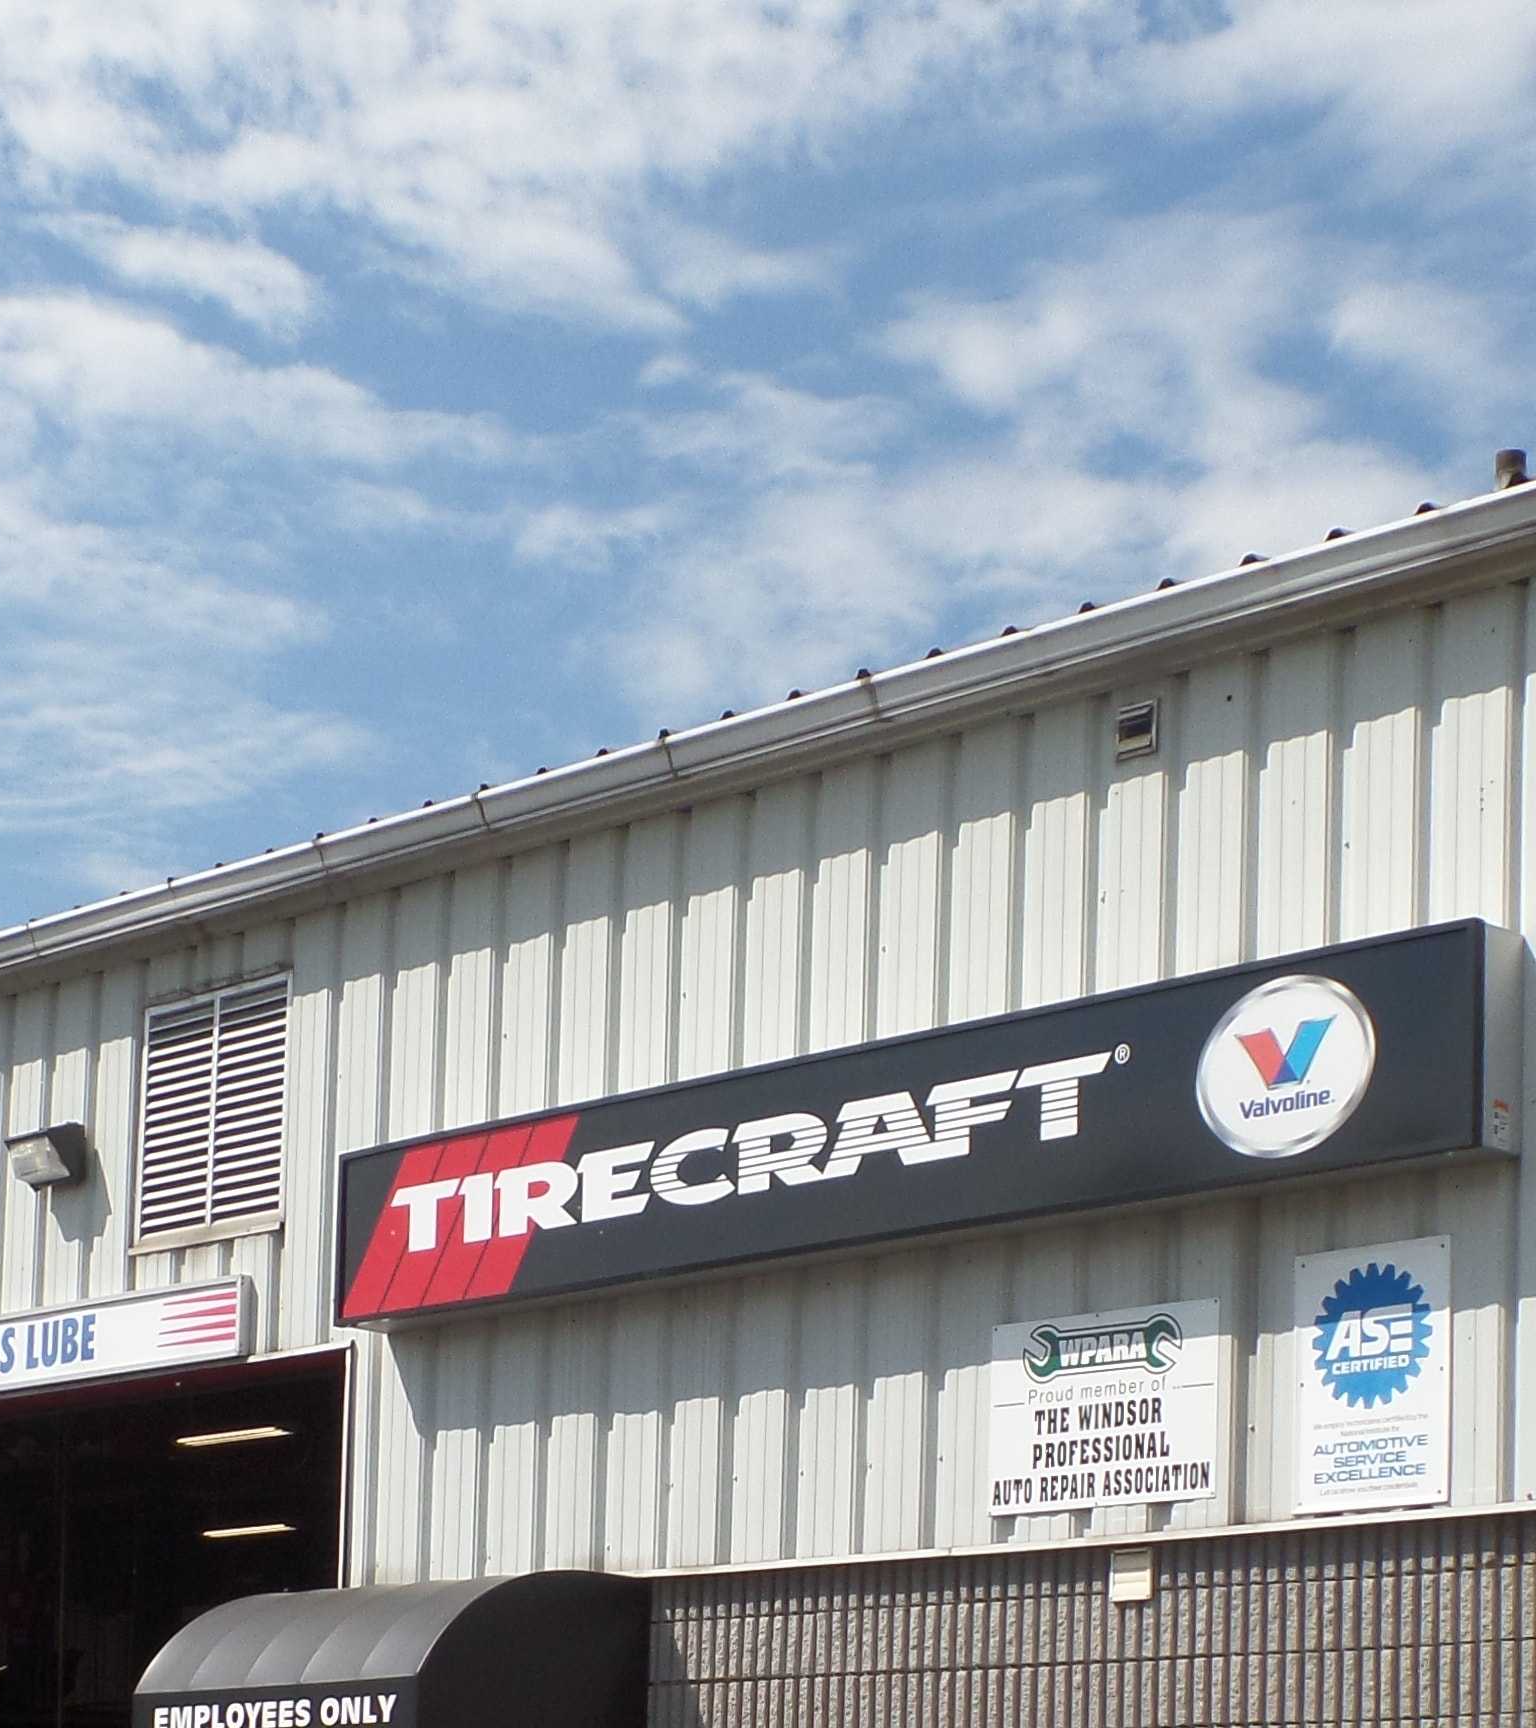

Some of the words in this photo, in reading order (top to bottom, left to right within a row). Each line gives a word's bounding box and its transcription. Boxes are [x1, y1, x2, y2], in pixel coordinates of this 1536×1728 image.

[1240, 1089, 1331, 1119] Valvoline
[26, 1314, 96, 1369] LUBE
[1325, 1303, 1413, 1360] ASE
[1058, 1330, 1147, 1367] WPARA
[1331, 1354, 1410, 1375] CERTIFIED
[1028, 1386, 1074, 1405] Proud
[1081, 1380, 1145, 1399] member
[1151, 1375, 1168, 1392] of
[1034, 1407, 1070, 1435] THE
[1079, 1398, 1162, 1431] WINDSOR
[1032, 1431, 1170, 1469] PROFESSIONAL
[1313, 1434, 1429, 1456] AUTOMOTIVE
[1333, 1451, 1407, 1468] SERVICE
[992, 1478, 1032, 1506] AUTO
[1040, 1472, 1096, 1503] REPAIR
[1102, 1461, 1211, 1497] ASSOCIATION
[1314, 1463, 1426, 1484] EXCELLENCE
[320, 1694, 397, 1726] ONLY
